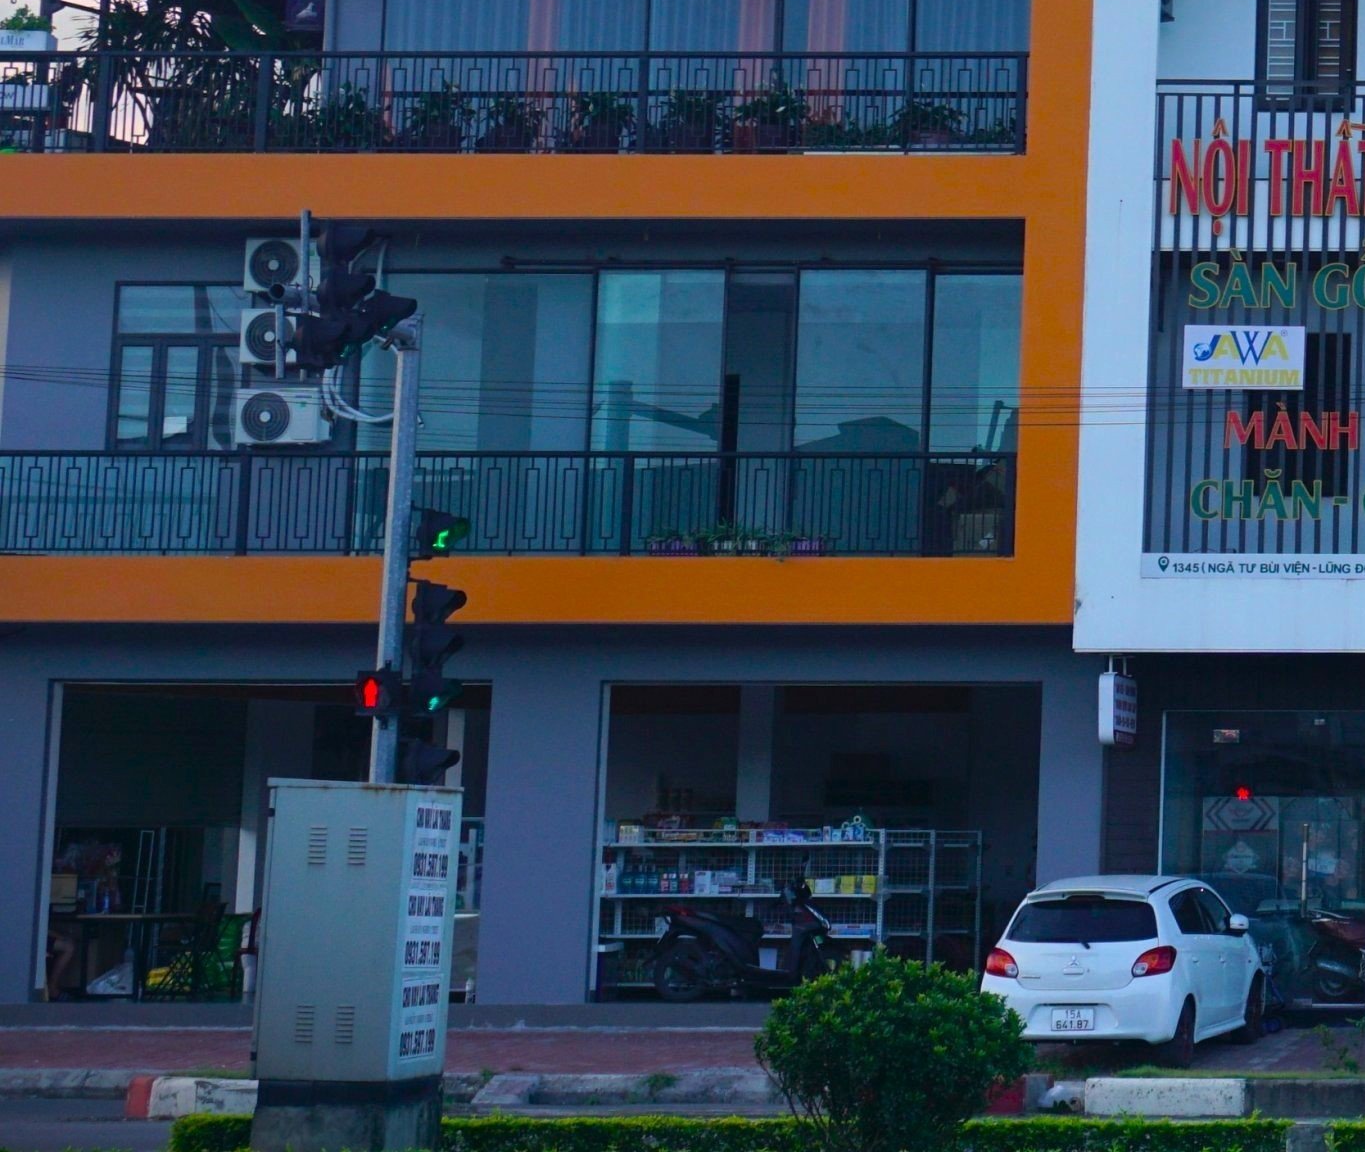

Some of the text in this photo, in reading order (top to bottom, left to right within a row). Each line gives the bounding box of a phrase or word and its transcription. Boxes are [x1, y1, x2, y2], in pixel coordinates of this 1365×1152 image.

[1169, 119, 1250, 236] NỘI
[1188, 248, 1297, 310] SÀN
[1188, 368, 1301, 386] TITANIUM
[1224, 401, 1359, 450] MÀNH
[1190, 468, 1323, 521] CHĂN
[1238, 563, 1257, 574] TƯ
